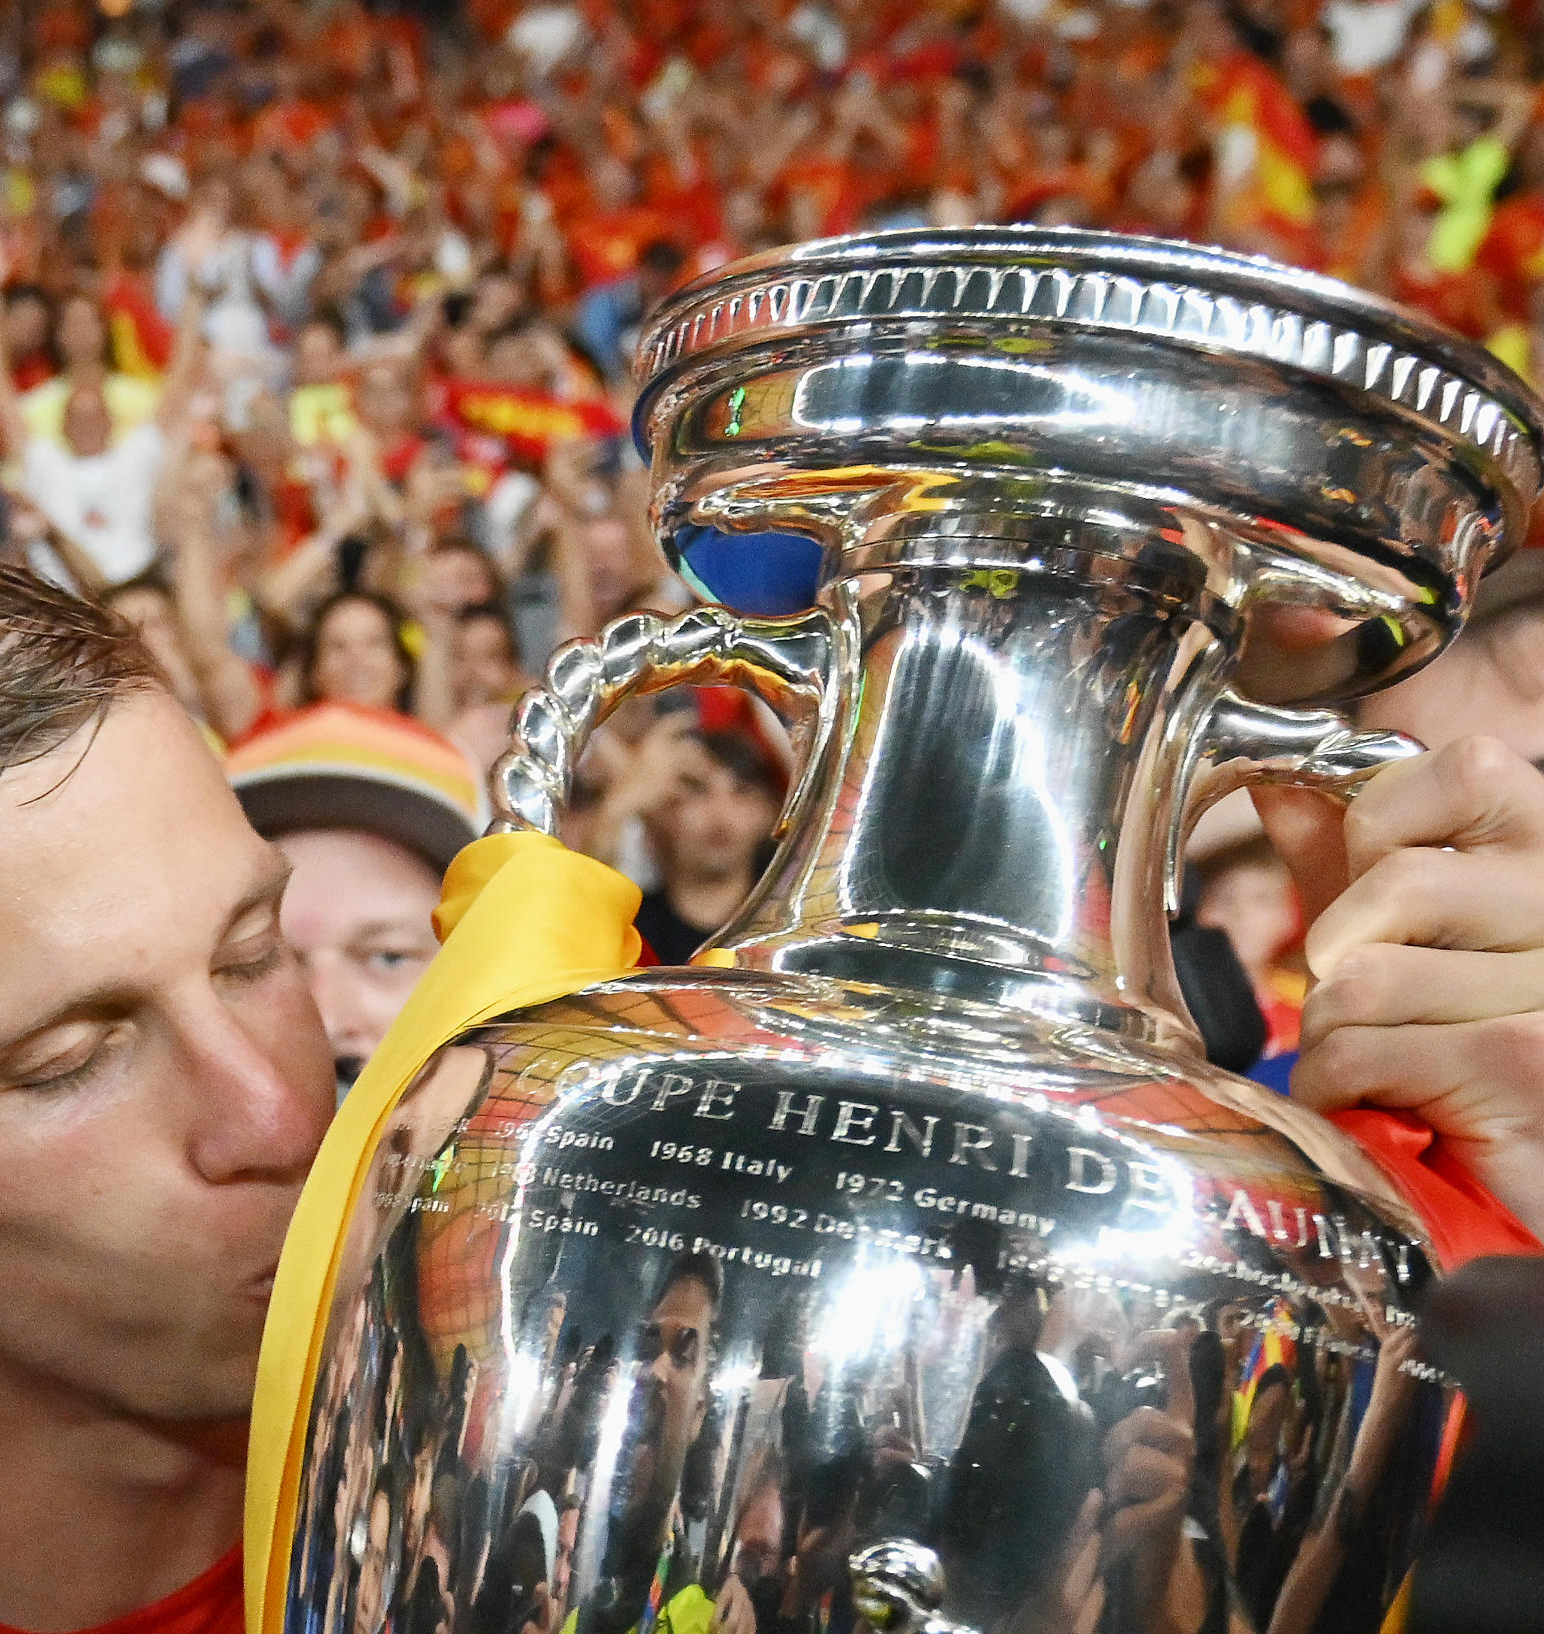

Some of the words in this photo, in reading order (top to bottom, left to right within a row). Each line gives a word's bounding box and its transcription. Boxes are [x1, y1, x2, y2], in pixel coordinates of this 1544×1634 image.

[543, 1166, 702, 1210] Netherlands
[740, 1199, 809, 1231] 1992
[544, 1124, 616, 1152] Spain
[650, 1139, 713, 1167] 1968
[720, 1151, 794, 1184] Italy
[834, 1171, 905, 1202] 1972
[913, 1186, 1057, 1238] Germany
[766, 1089, 1034, 1179] HENRI
[1065, 1145, 1173, 1215] DE
[528, 1207, 600, 1238] Spain
[623, 1223, 685, 1252] 2016
[691, 1235, 824, 1280] Portugal
